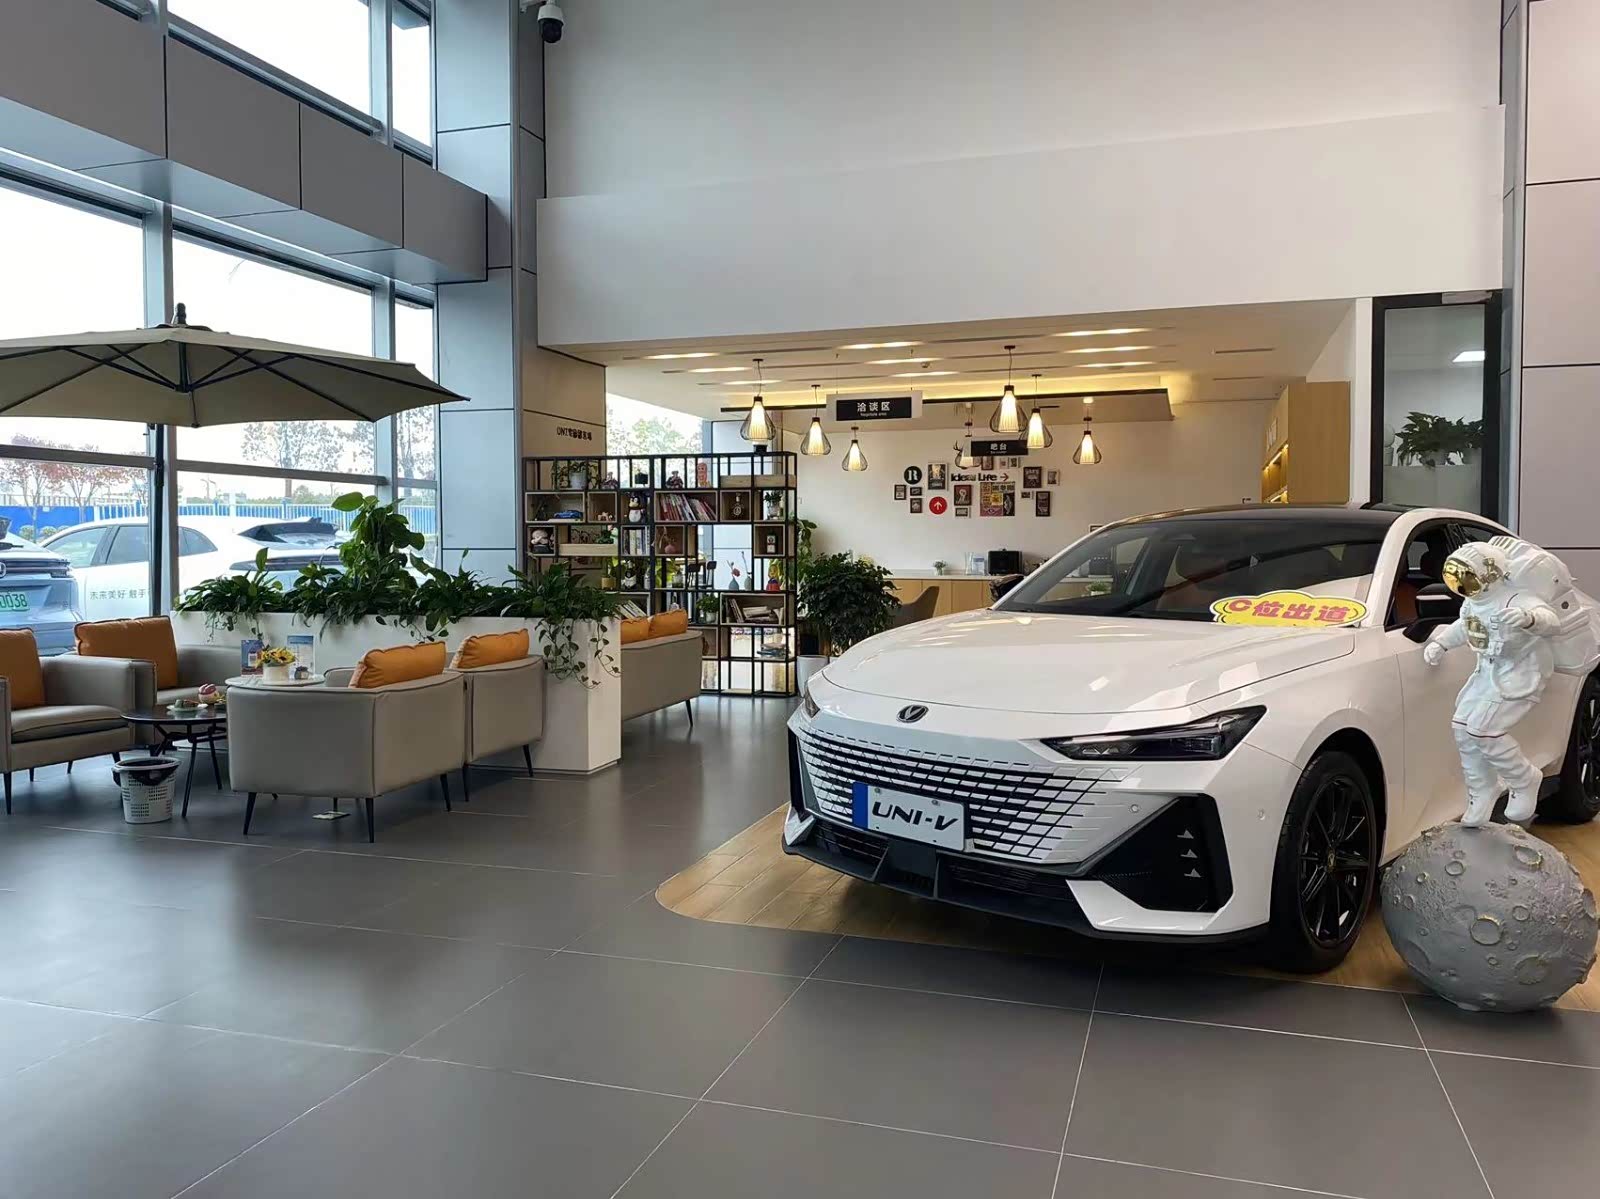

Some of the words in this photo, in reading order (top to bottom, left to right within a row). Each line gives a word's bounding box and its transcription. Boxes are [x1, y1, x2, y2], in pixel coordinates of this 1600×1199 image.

[857, 402, 890, 412] 洽谈区
[990, 443, 1007, 451] 吧台
[978, 473, 997, 481] Life
[90, 590, 126, 600] 未来美好
[1228, 599, 1350, 622] C位出道
[872, 801, 958, 831] UNI-V
